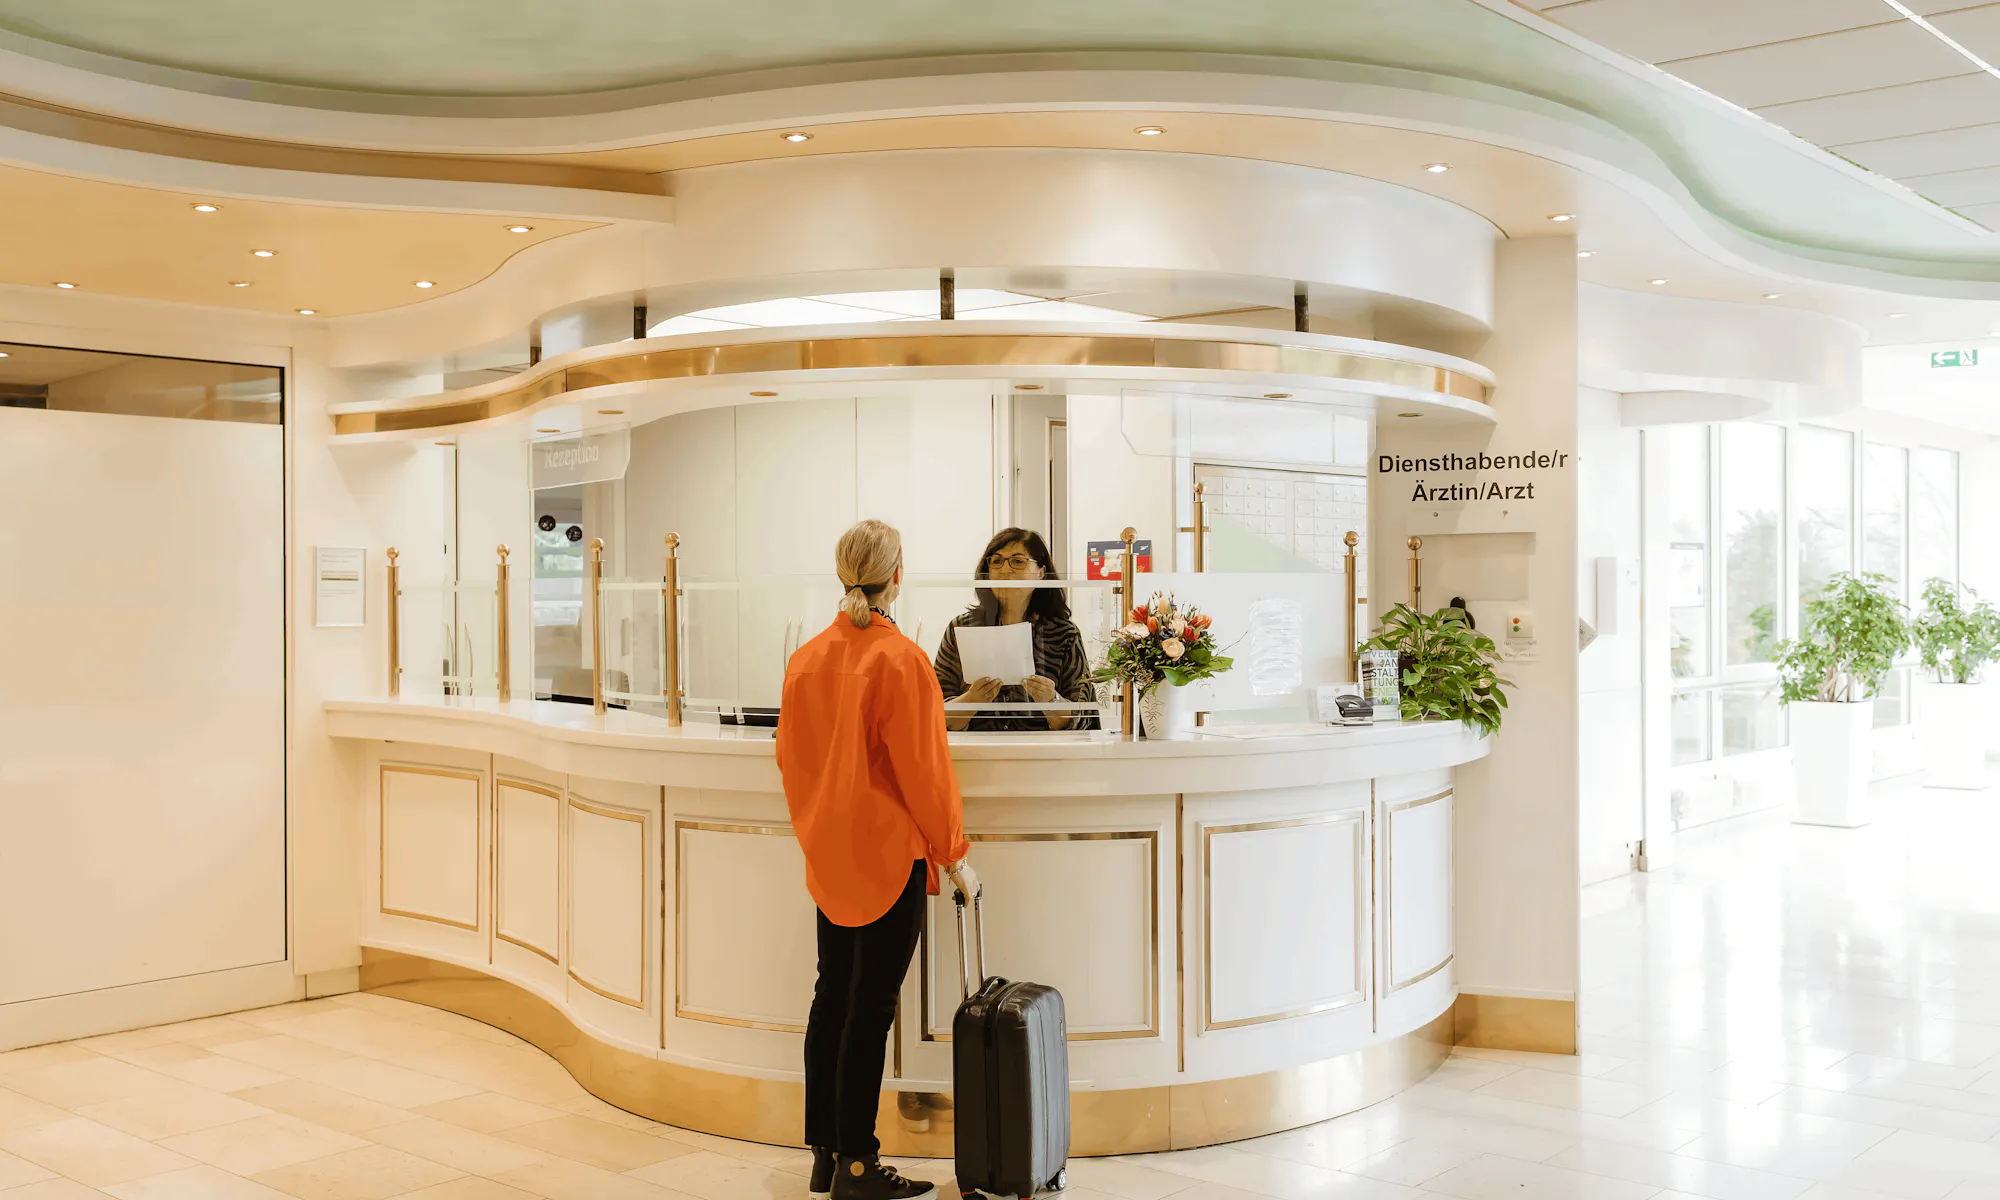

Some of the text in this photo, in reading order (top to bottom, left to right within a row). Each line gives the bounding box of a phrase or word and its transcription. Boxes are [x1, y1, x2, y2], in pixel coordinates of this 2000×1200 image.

[543, 441, 600, 471] Rezeption
[1378, 450, 1568, 473] Diensthabende/r
[1412, 480, 1534, 502] Ärztin/Arzt
